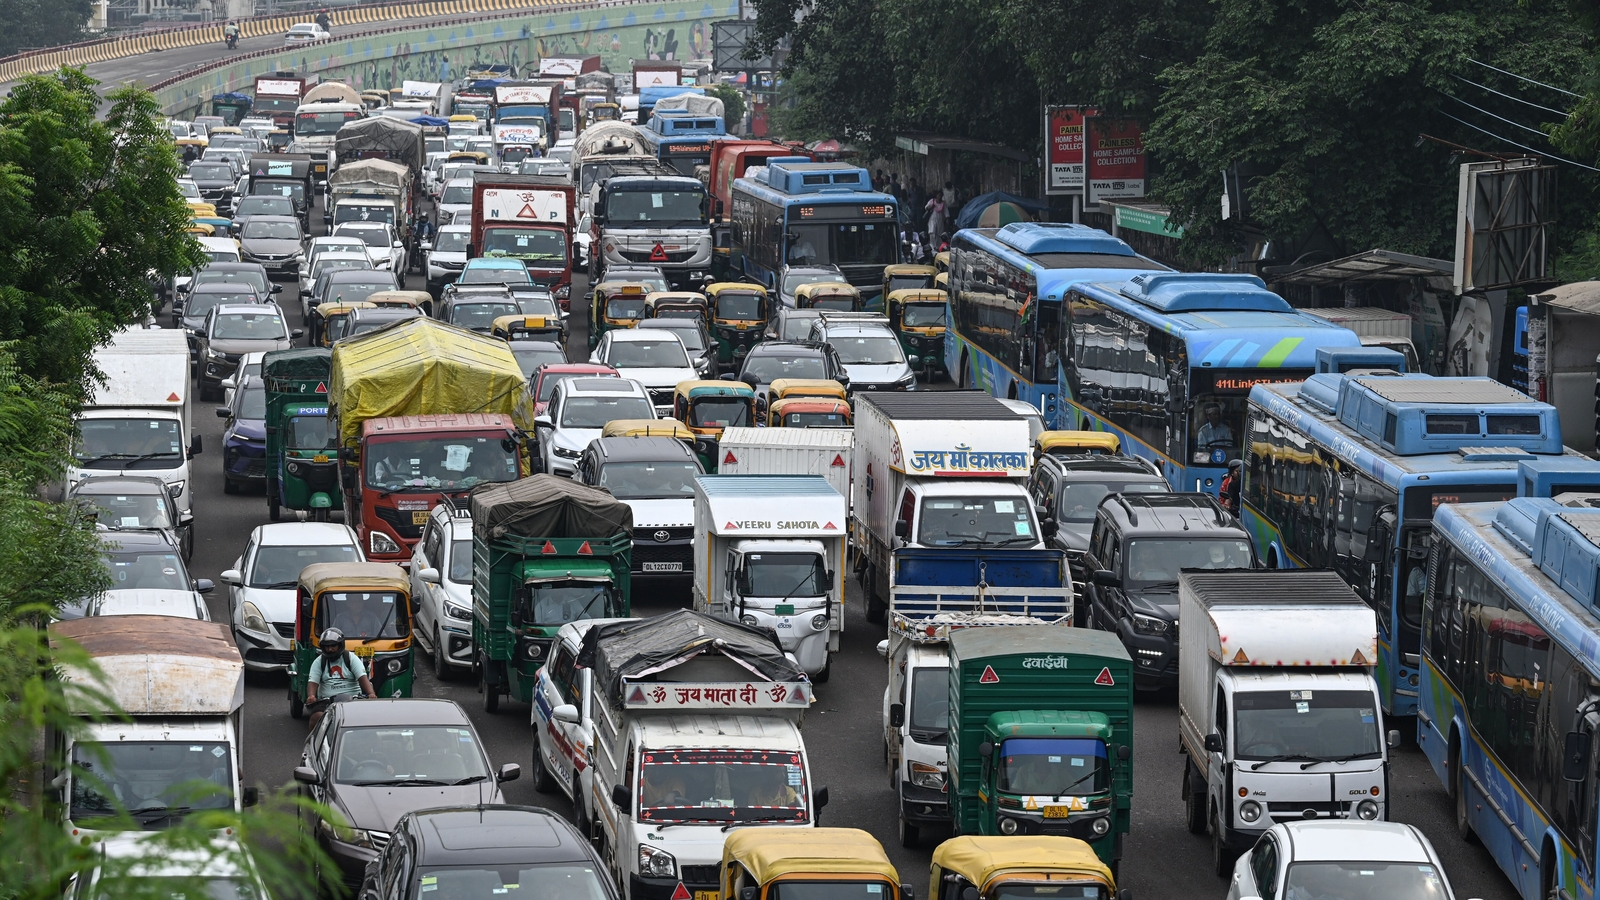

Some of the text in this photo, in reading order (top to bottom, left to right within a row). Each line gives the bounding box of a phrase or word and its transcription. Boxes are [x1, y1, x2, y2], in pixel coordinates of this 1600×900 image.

[1060, 126, 1083, 134] PAINLE
[1059, 143, 1083, 151] COLLECT
[1099, 138, 1135, 148] PAINLESS
[1093, 148, 1141, 158] HOME SAMPLE
[1097, 156, 1137, 166] COLLECTION
[491, 209, 558, 220] N P
[1279, 403, 1302, 428] ELECTRIC
[910, 450, 947, 471] जय
[969, 450, 1029, 471] कालका
[735, 520, 820, 529] VEERU SAHOTA
[1471, 537, 1496, 569] ELECTRIC
[1540, 602, 1566, 631] SMOKE
[674, 687, 701, 704] जय
[703, 687, 736, 705] माता
[739, 683, 759, 705] दी
